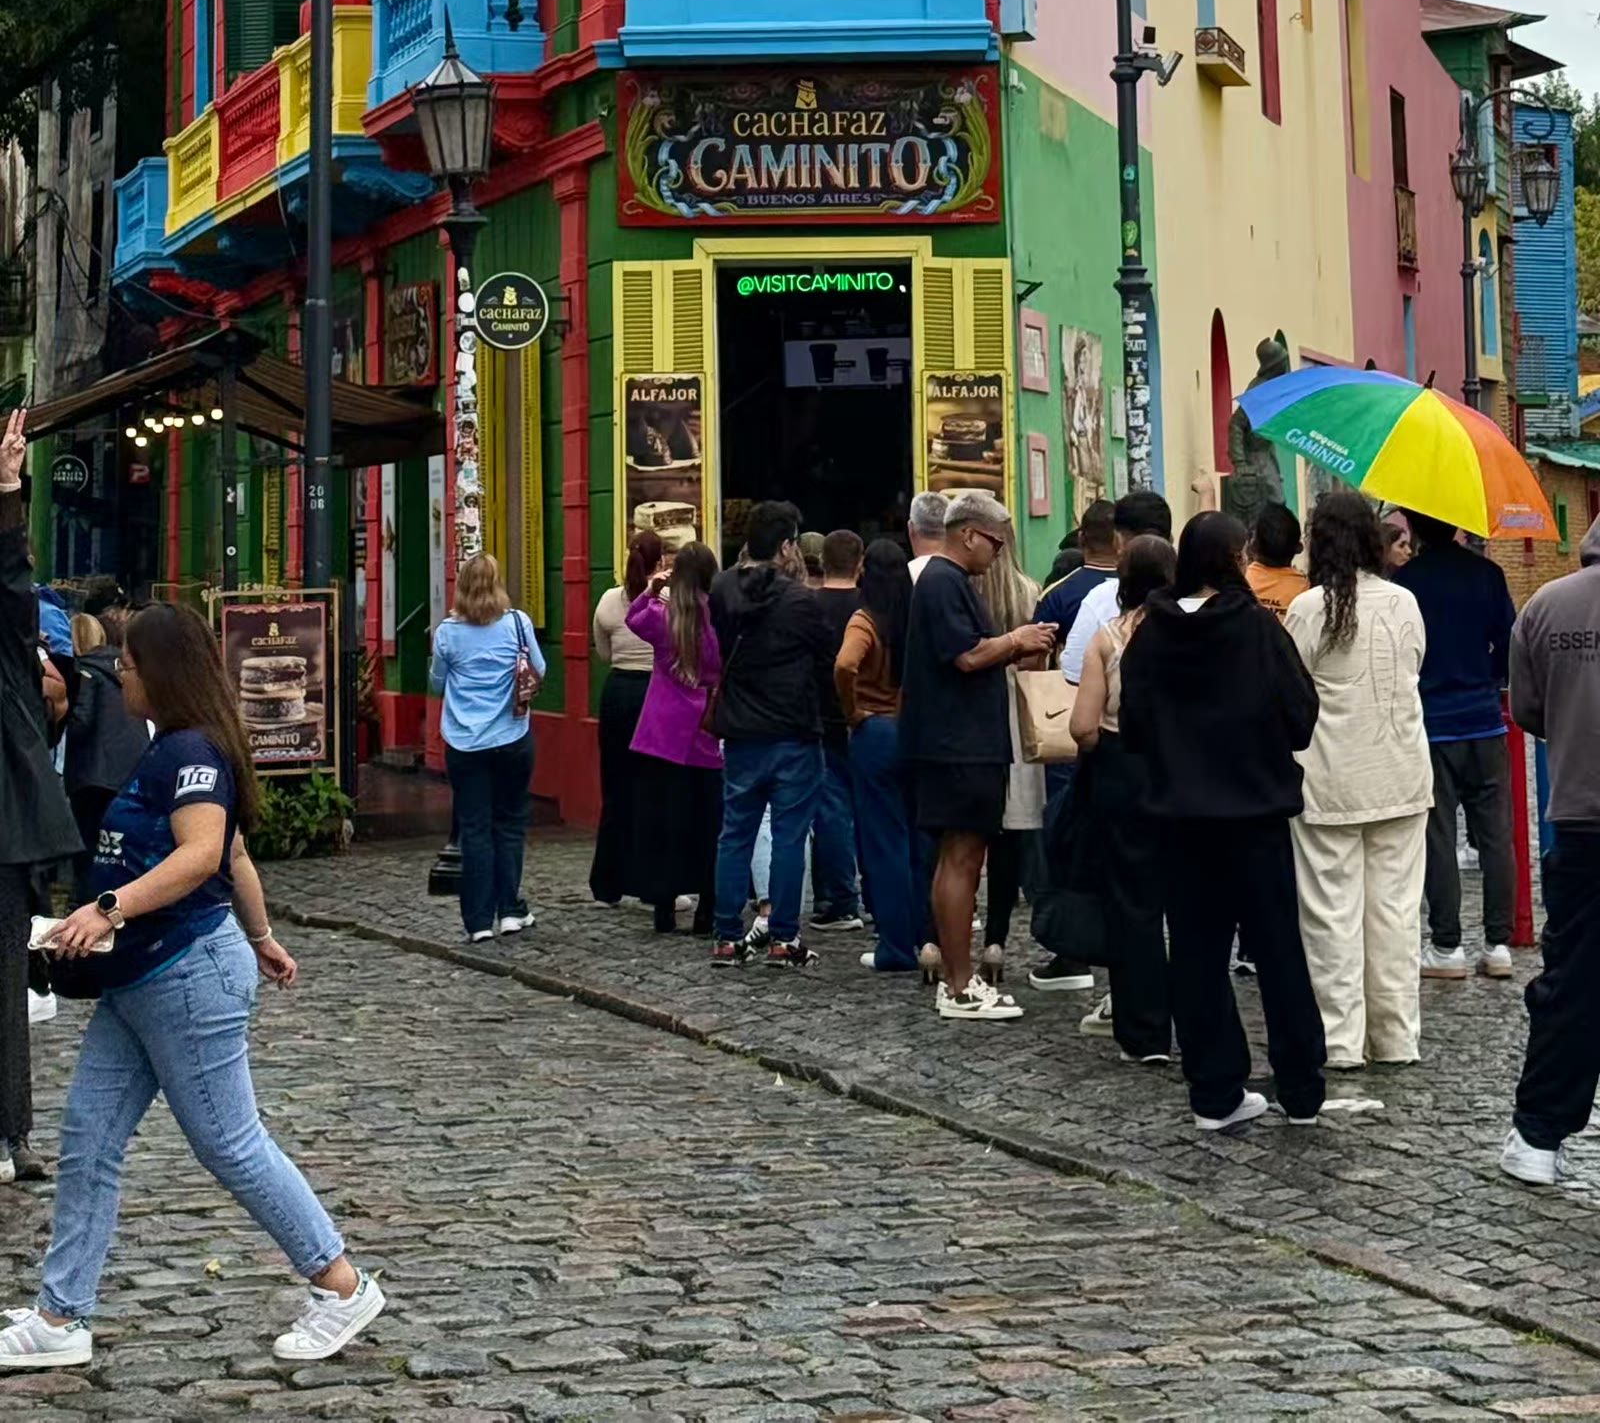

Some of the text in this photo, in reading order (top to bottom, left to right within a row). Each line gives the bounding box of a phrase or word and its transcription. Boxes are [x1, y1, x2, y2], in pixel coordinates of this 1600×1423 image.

[688, 135, 931, 192] CAMINITO
[747, 193, 872, 205] BUENOS AIRES
[737, 272, 894, 296] @VISITCAMINITO
[491, 322, 530, 332] CAMINITO
[631, 388, 698, 402] ALFAJOR
[933, 385, 1000, 399] ALFAJOR
[1285, 428, 1355, 474] CAMINITO
[249, 732, 300, 746] CAMINITO
